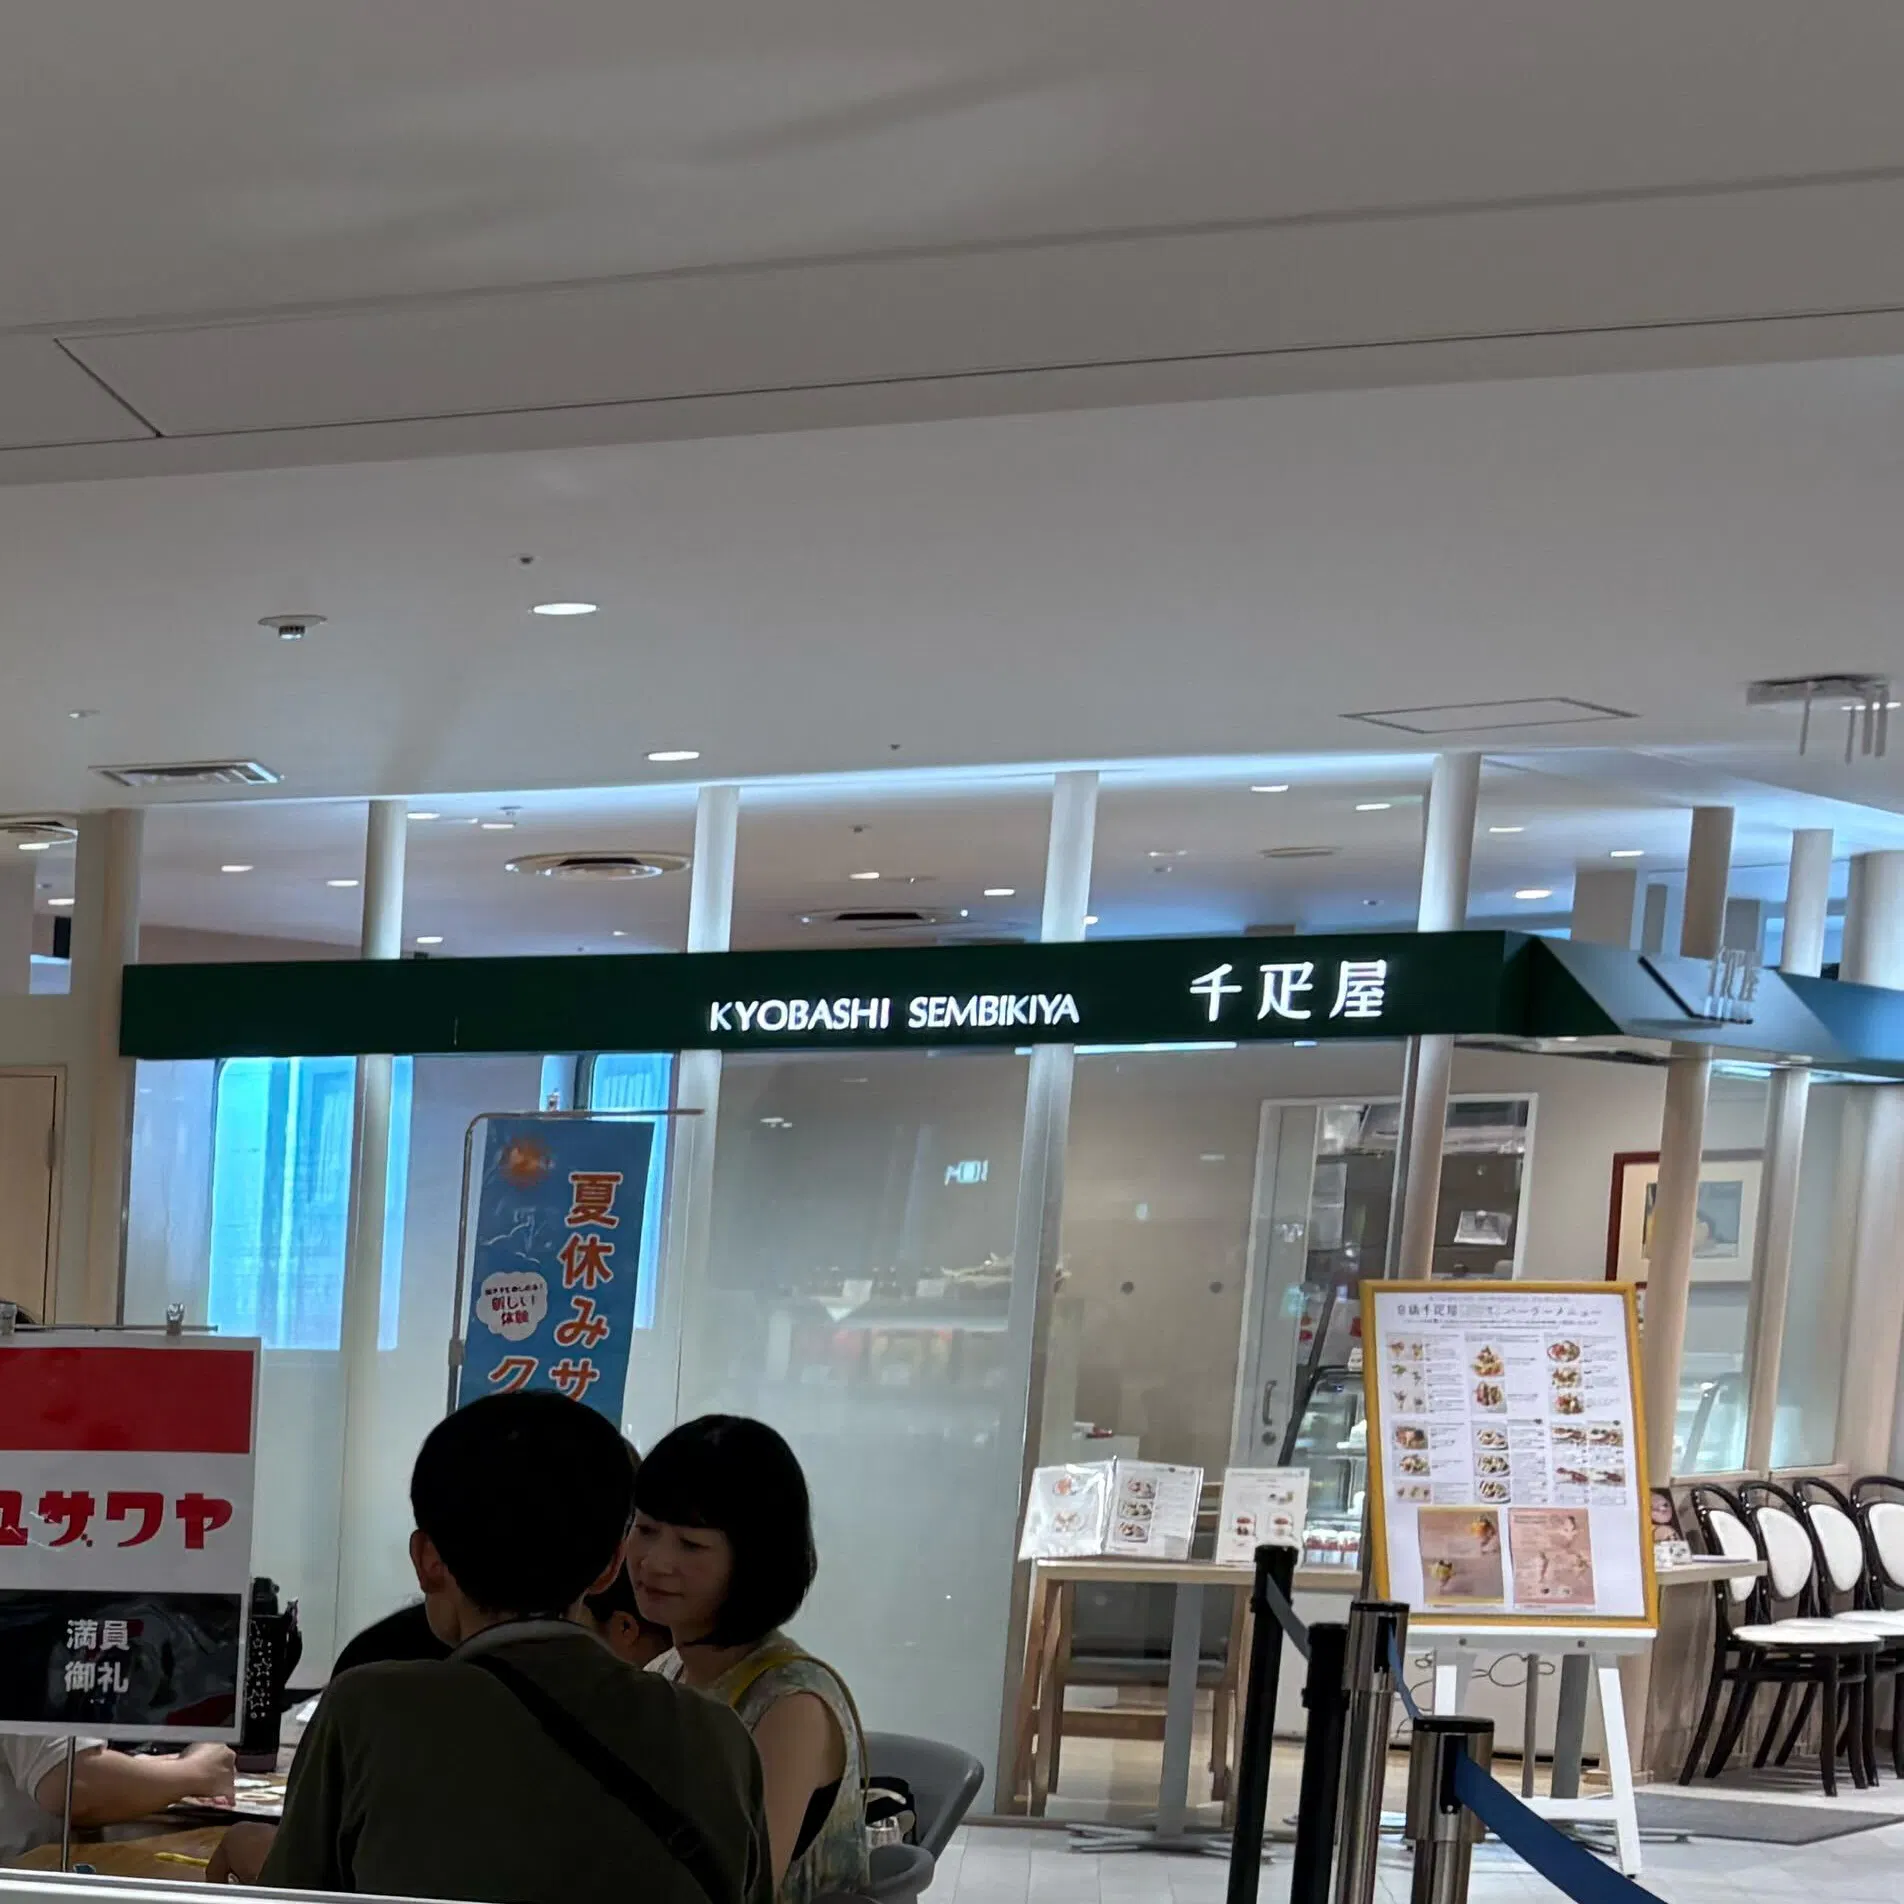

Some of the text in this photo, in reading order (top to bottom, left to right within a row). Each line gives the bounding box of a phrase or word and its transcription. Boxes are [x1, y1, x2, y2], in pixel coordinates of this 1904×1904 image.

[1189, 958, 1388, 1023] 千疋屋
[710, 993, 1080, 1032] KYOBASHI SEMBIKIYA
[66, 1619, 130, 1652] 満員
[64, 1661, 129, 1694] 御礼
